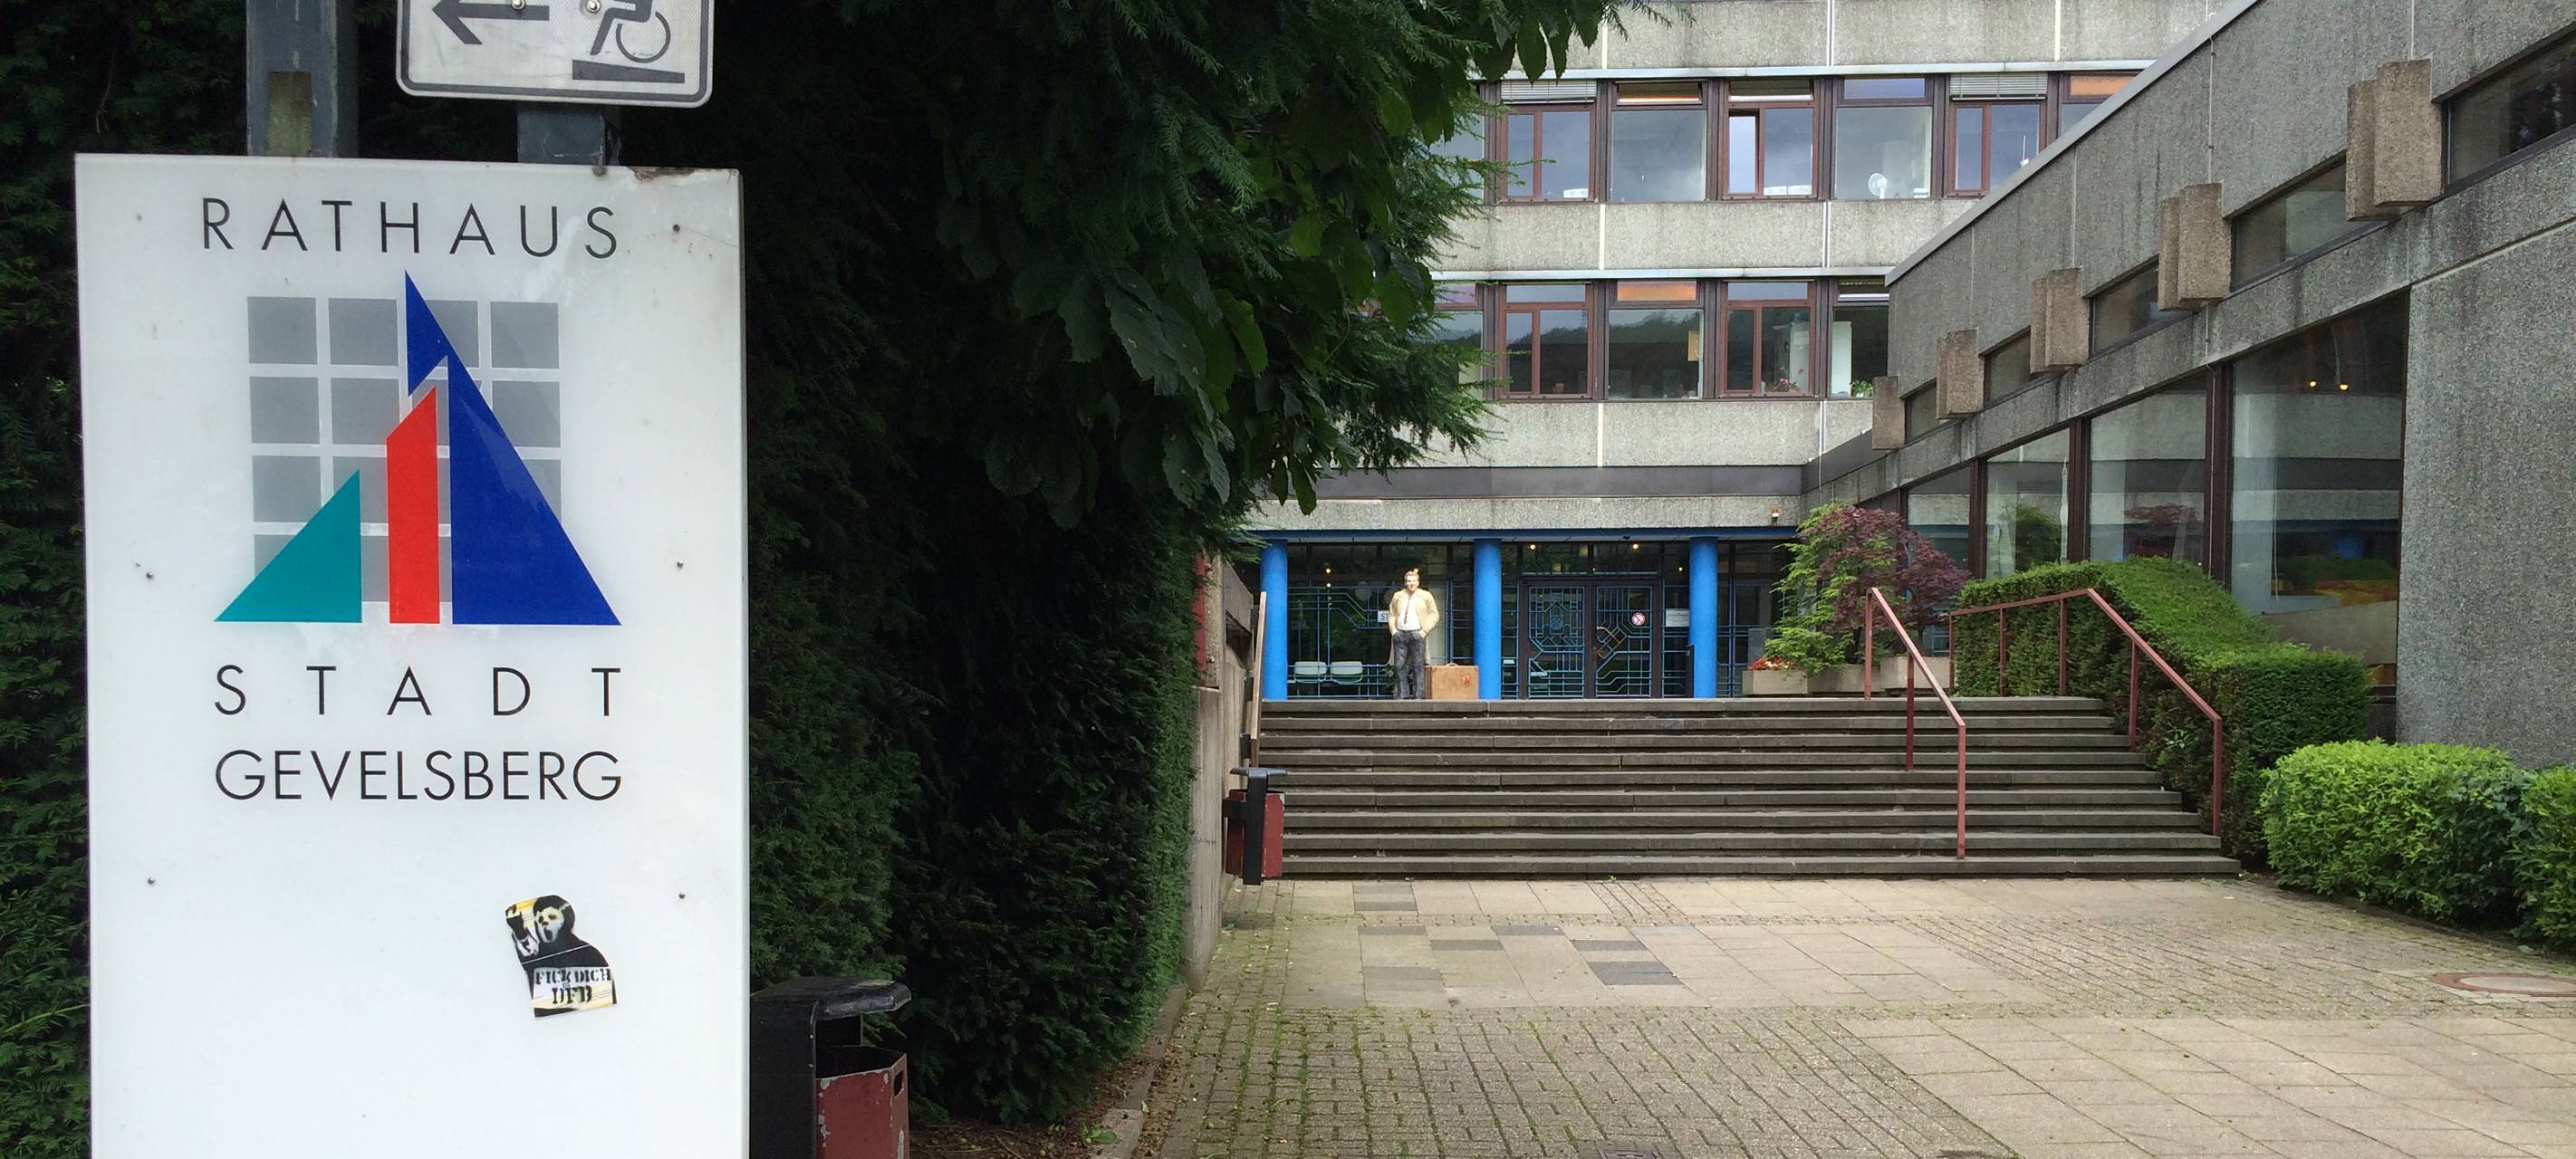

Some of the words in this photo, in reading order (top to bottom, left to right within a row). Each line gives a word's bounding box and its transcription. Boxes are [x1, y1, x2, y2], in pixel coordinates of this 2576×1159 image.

[202, 197, 618, 260] RATHAUS
[215, 665, 621, 717] STADT
[216, 750, 622, 801] GEVELSBERG
[535, 969, 571, 985] FICK
[574, 968, 611, 983] DICH
[552, 985, 592, 1004] DFB
